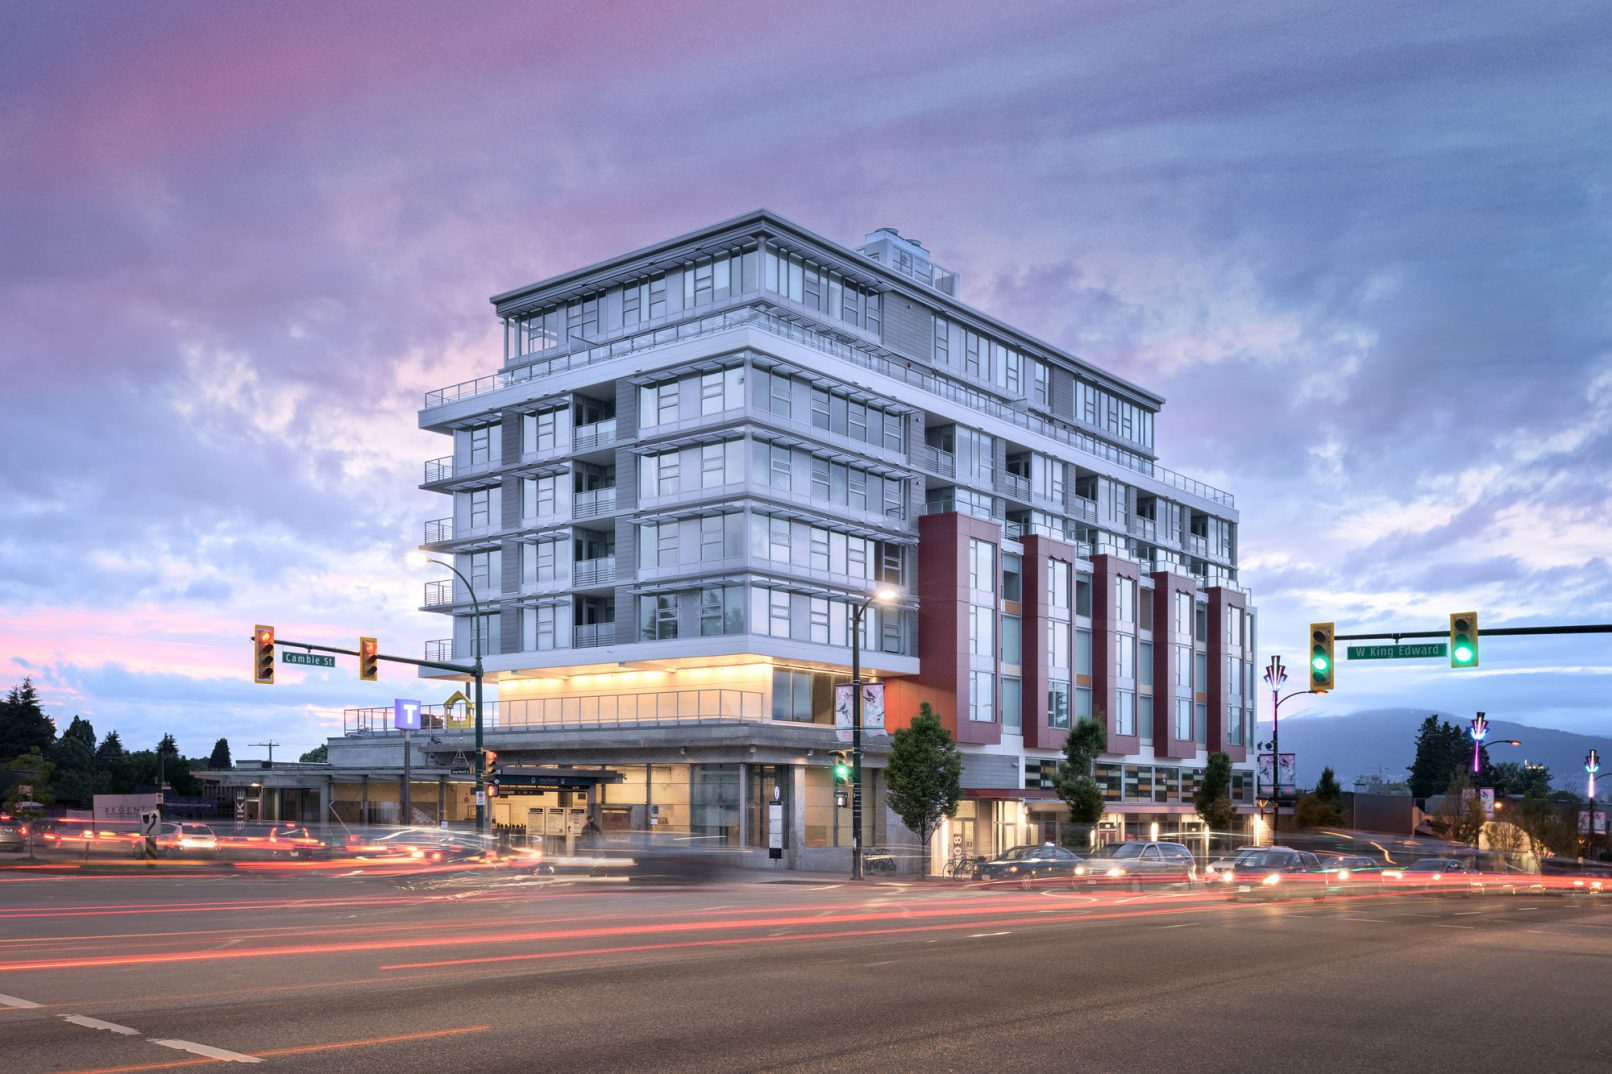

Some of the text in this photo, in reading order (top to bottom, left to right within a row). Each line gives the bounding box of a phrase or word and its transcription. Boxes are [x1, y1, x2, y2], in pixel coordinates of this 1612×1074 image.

[286, 653, 332, 666] Cambie St
[1356, 644, 1439, 659] W King Edward
[403, 704, 418, 725] T
[236, 790, 245, 830] BIKE
